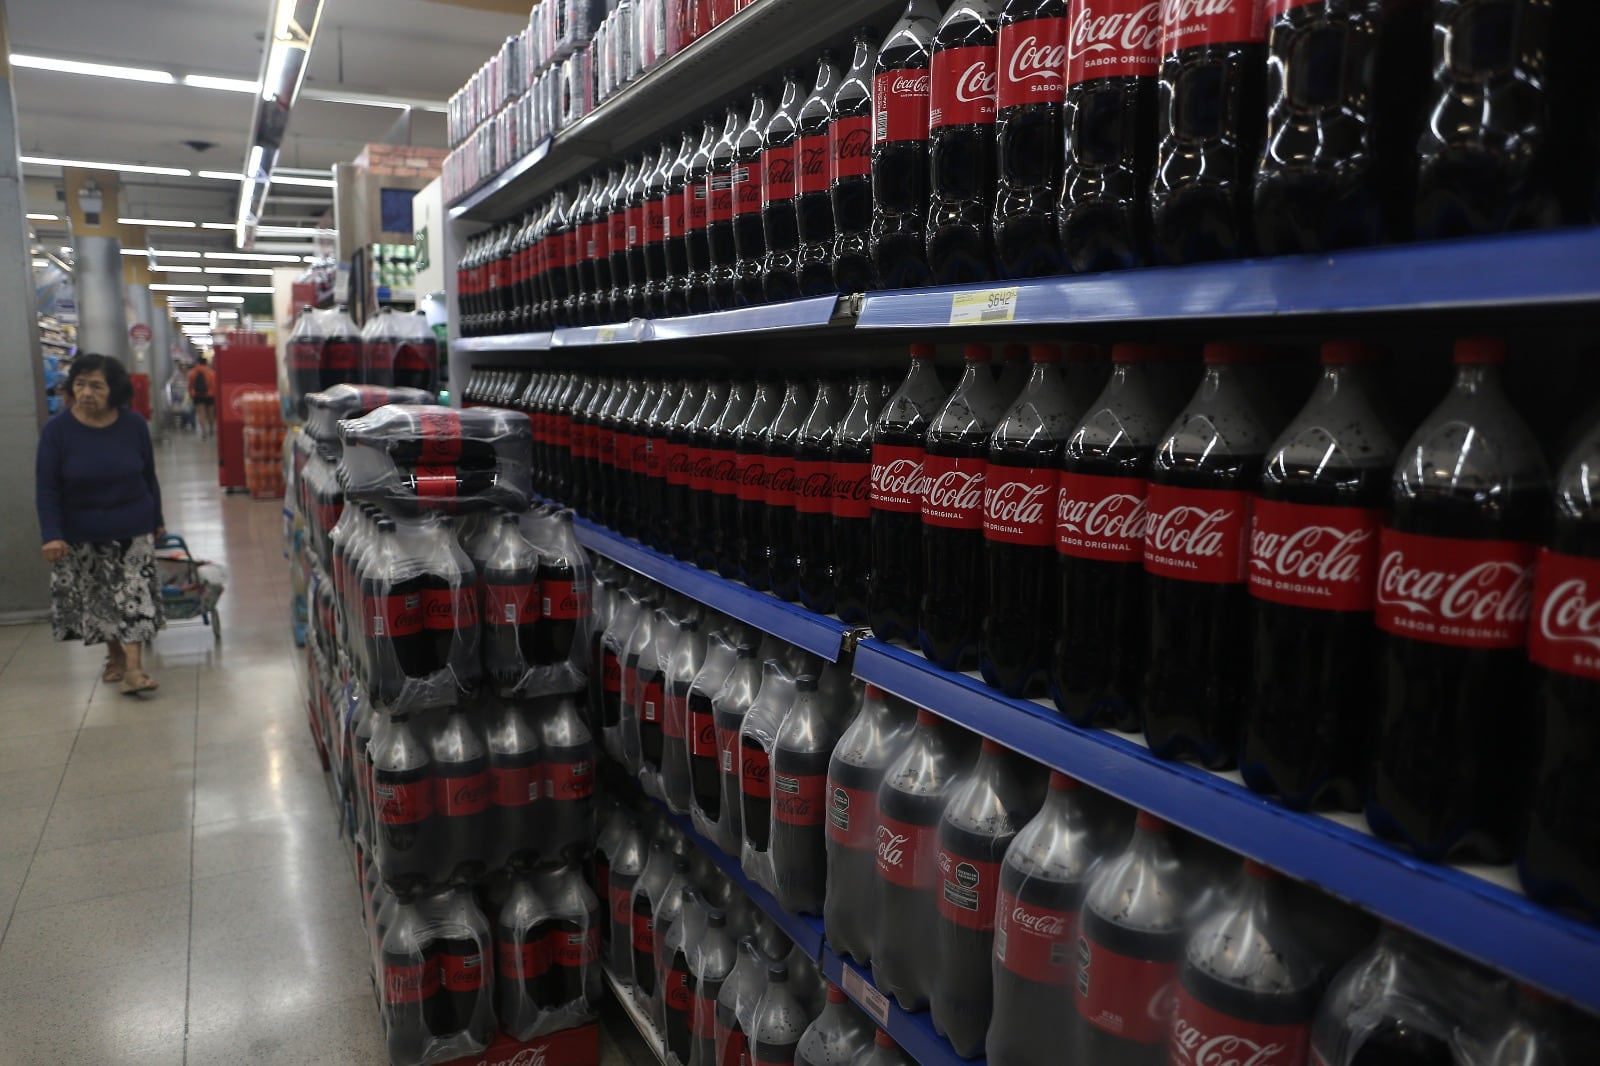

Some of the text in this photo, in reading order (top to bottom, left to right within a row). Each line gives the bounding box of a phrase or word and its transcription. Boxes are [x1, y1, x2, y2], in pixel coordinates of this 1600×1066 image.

[1084, 56, 1118, 68] SABOR
[880, 495, 911, 504] ORIGINAL
[931, 510, 963, 519] ORIGINAL
[989, 523, 1024, 534] ORIGINAL
[1085, 540, 1133, 551] ORIGINAL
[1154, 554, 1198, 569] ORIGINAL
[1275, 581, 1333, 596] ORIGINAL
[1377, 551, 1534, 621] Coca-Cola
[1394, 616, 1510, 641] SABOR ORIGINAL
